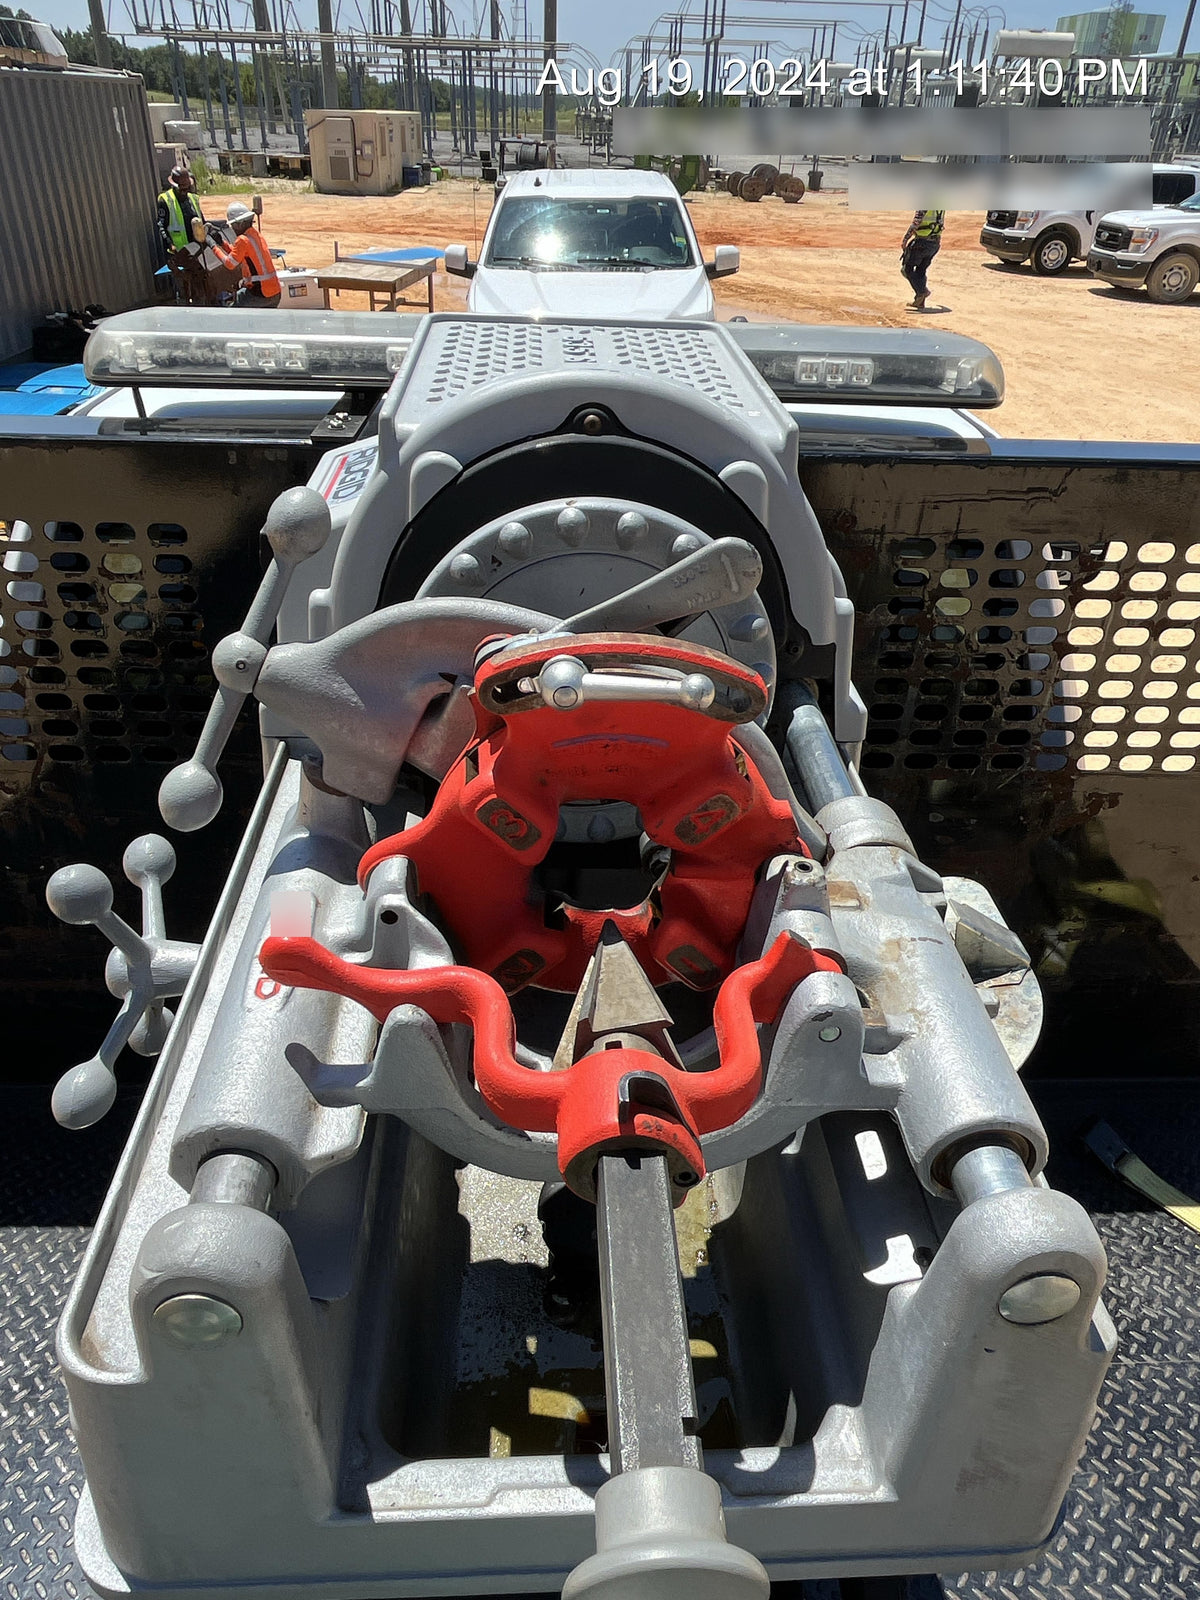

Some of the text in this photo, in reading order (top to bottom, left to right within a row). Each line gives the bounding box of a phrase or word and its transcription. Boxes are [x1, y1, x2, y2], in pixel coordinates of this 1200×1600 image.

[332, 446, 379, 500] RIDGID
[490, 808, 528, 839] 3
[690, 809, 727, 835] 4
